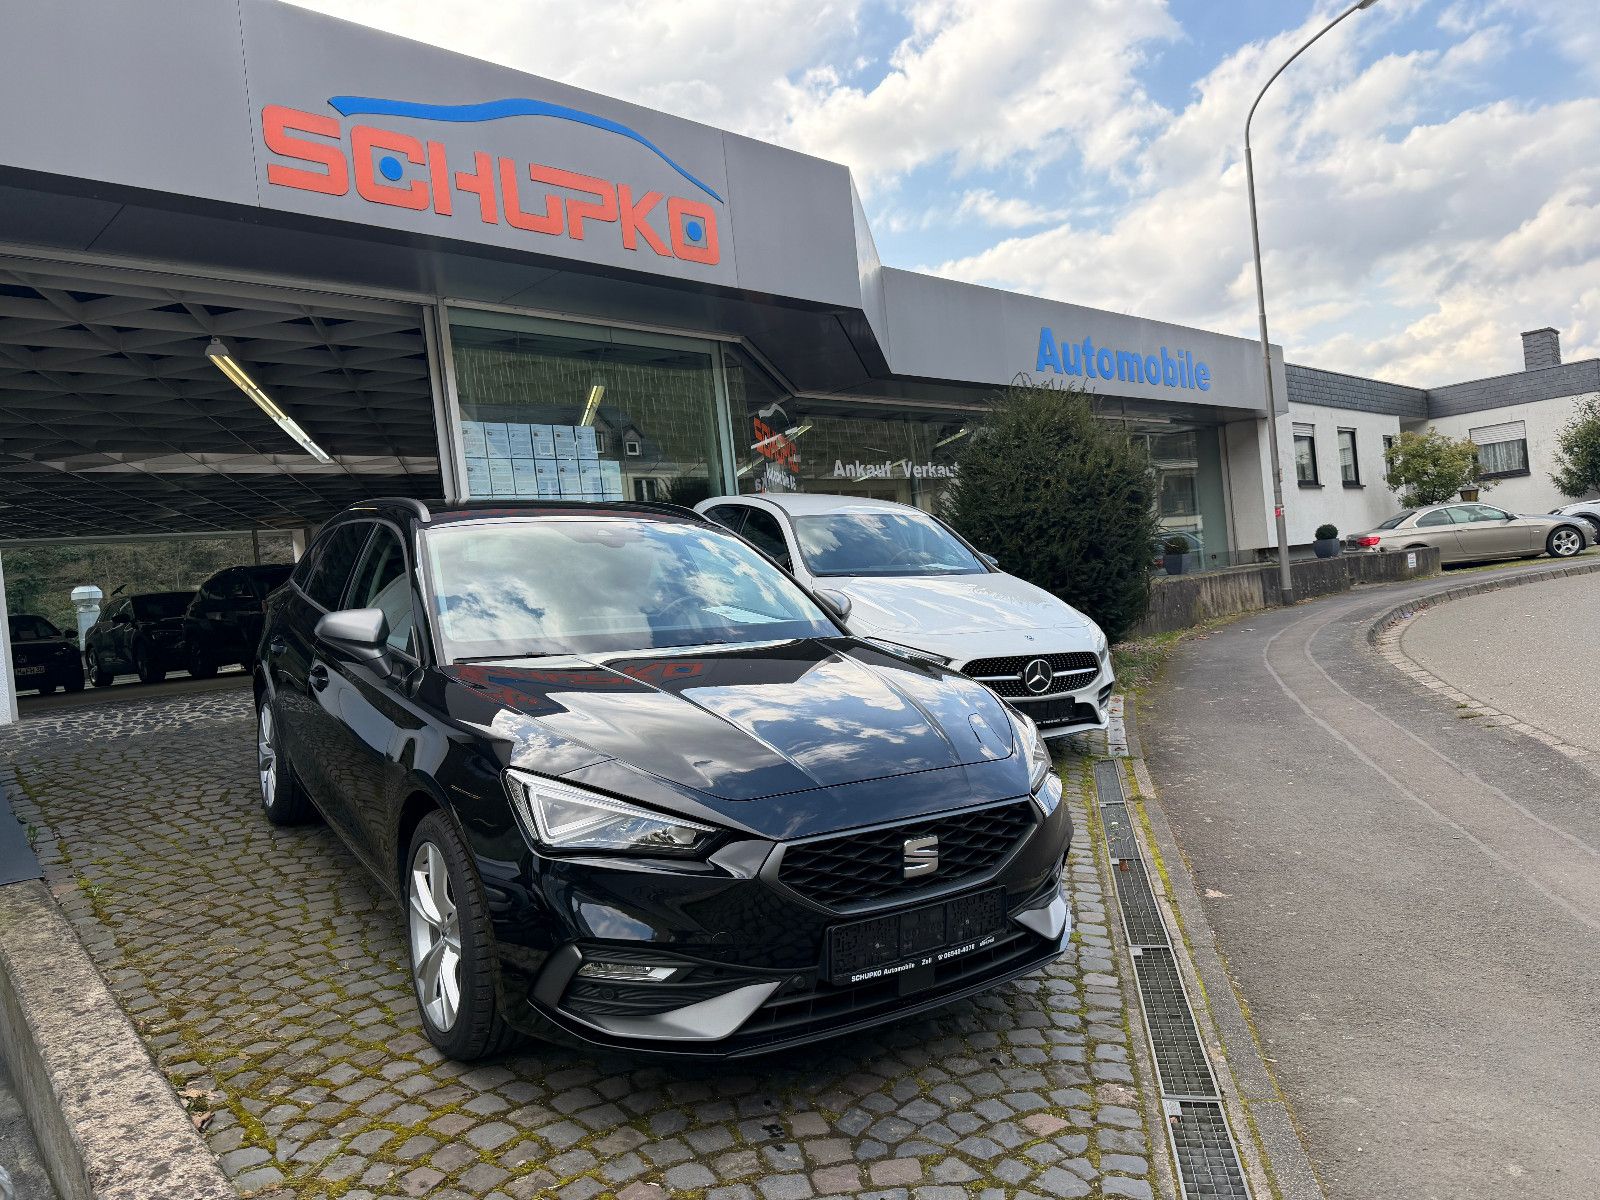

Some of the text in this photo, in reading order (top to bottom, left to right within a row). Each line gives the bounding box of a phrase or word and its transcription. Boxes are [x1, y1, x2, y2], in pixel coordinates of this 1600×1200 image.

[261, 104, 720, 265] SCHUPKO
[1036, 327, 1212, 391] Automobile
[833, 459, 892, 477] Ankauf
[851, 969, 882, 982] SCHUPKO
[883, 962, 916, 976] Automobile
